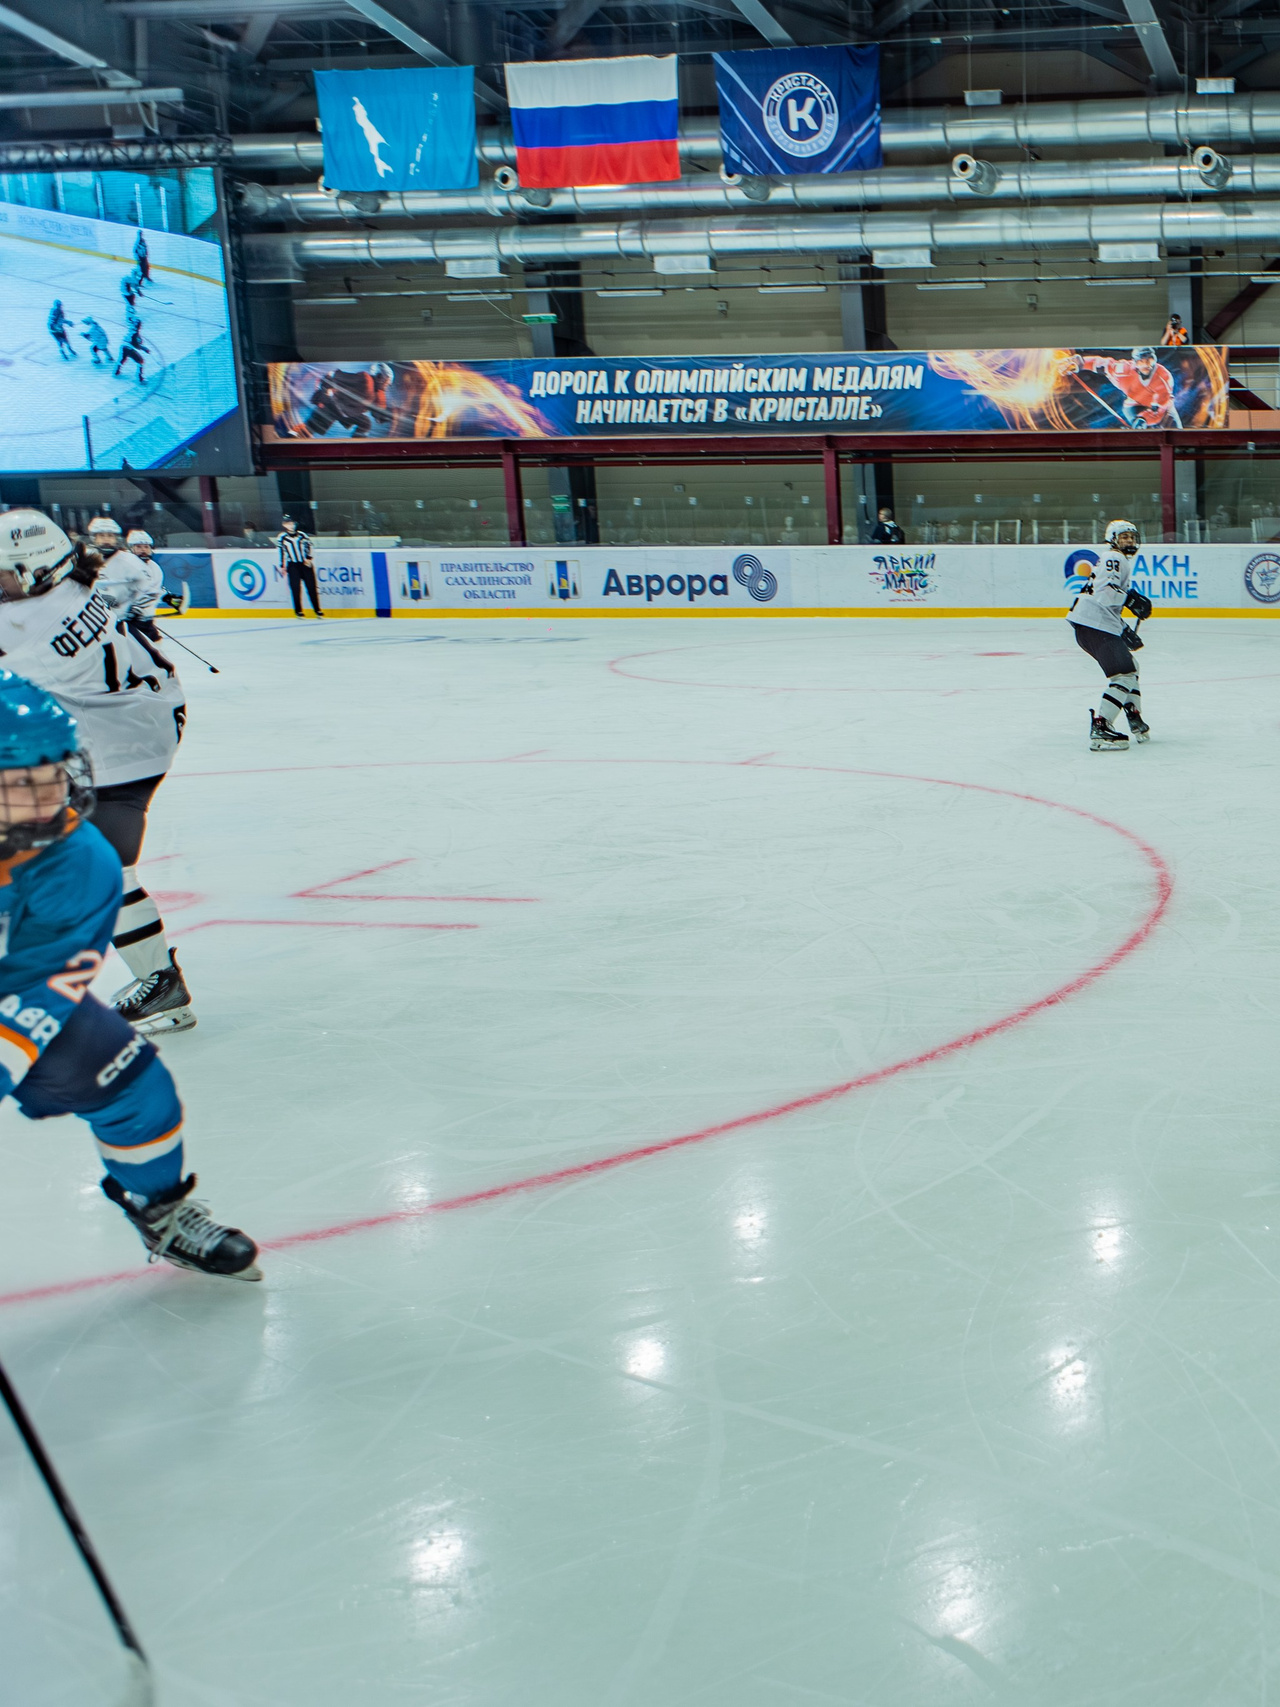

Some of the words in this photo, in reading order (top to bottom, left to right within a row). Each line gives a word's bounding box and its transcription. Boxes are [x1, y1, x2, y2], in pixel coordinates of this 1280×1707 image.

[530, 370, 608, 398] ДОРОГА
[614, 371, 630, 394] К
[635, 363, 808, 394] ОЛИМПИЙСКИМ
[812, 365, 924, 394] МЕДАЛЯМ
[576, 399, 707, 424] НАЧИНАЕТСЯ
[713, 399, 728, 423] В
[735, 396, 883, 422] «КРИСТАЛЛЕ»
[273, 564, 363, 583] Мскан
[440, 562, 534, 573] ПРАВИТЕЛЬСТВО
[1132, 555, 1198, 577] AKH.
[445, 574, 532, 586] САХАЛИНСКОЙ
[602, 568, 729, 602] Аврора
[1131, 580, 1198, 598] NLINE
[463, 589, 516, 600] ОБЛАСТИ
